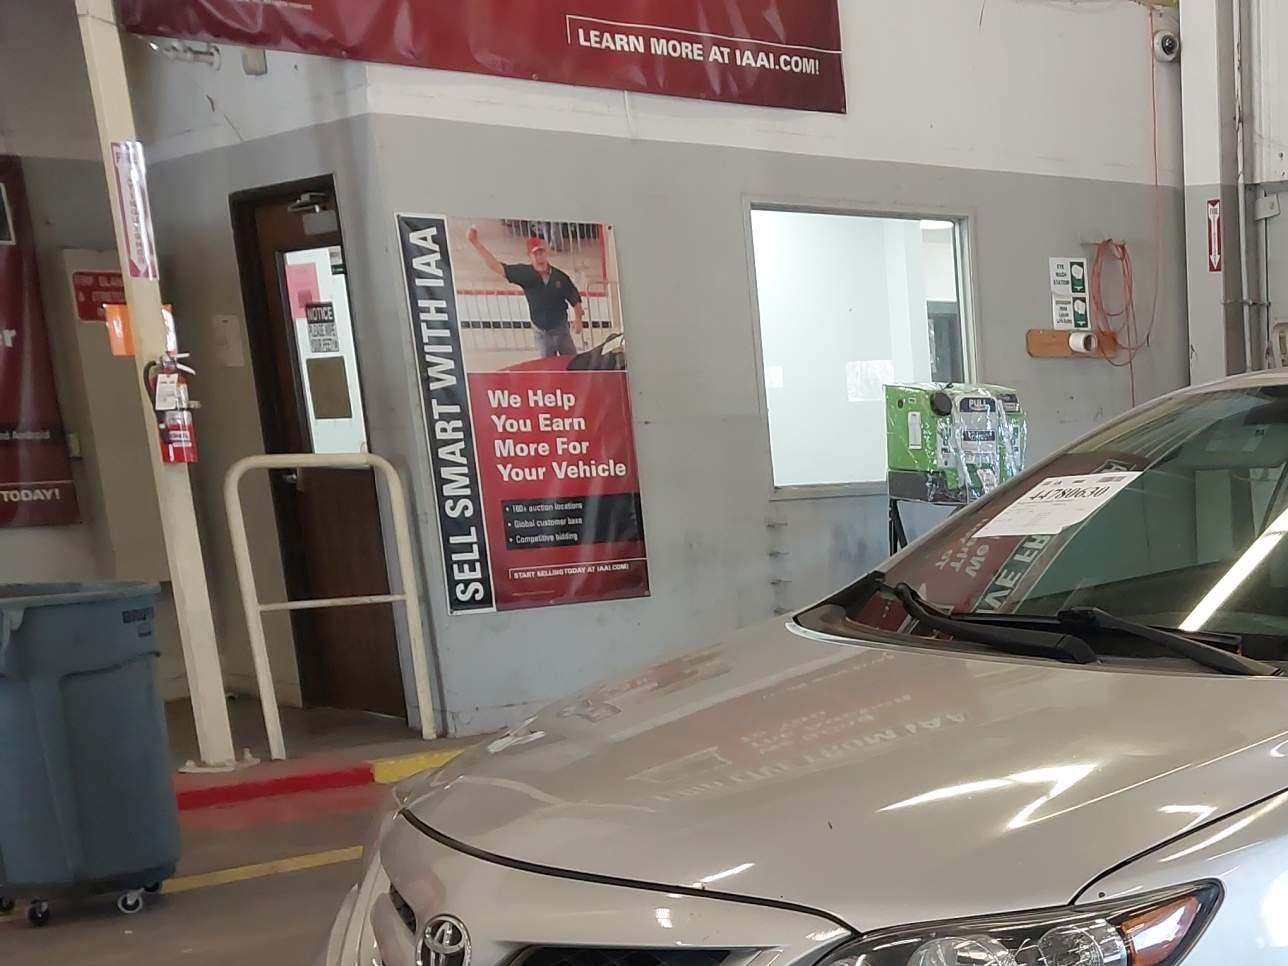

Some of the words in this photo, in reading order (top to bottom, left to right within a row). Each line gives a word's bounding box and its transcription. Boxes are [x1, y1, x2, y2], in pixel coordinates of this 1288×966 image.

[578, 28, 644, 53] LEARN
[650, 37, 704, 60] MORE
[708, 46, 731, 64] AT
[735, 50, 820, 75] IAAI.COM!
[410, 226, 445, 287] IAA
[307, 306, 334, 321] NOTICE
[418, 299, 457, 391] WITH
[488, 389, 521, 408] We
[527, 389, 576, 410] Help
[969, 399, 986, 407] PULL
[491, 414, 532, 433] You
[538, 414, 586, 431] Earn
[494, 439, 550, 457] More
[556, 437, 589, 455] For
[432, 398, 474, 518] SMART
[497, 464, 546, 482] Your
[552, 459, 626, 479] Vehicle
[0, 488, 61, 502] TODAY!
[529, 504, 554, 512] auction
[554, 502, 583, 510] locations
[514, 519, 535, 528] Global
[536, 518, 566, 527] customer
[515, 534, 554, 544] Competitive
[555, 532, 578, 541] bidding
[450, 525, 485, 601] SELL
[513, 572, 536, 580] START
[537, 569, 563, 577] SELLING
[564, 567, 586, 576] TODAY
[587, 565, 596, 573] AT
